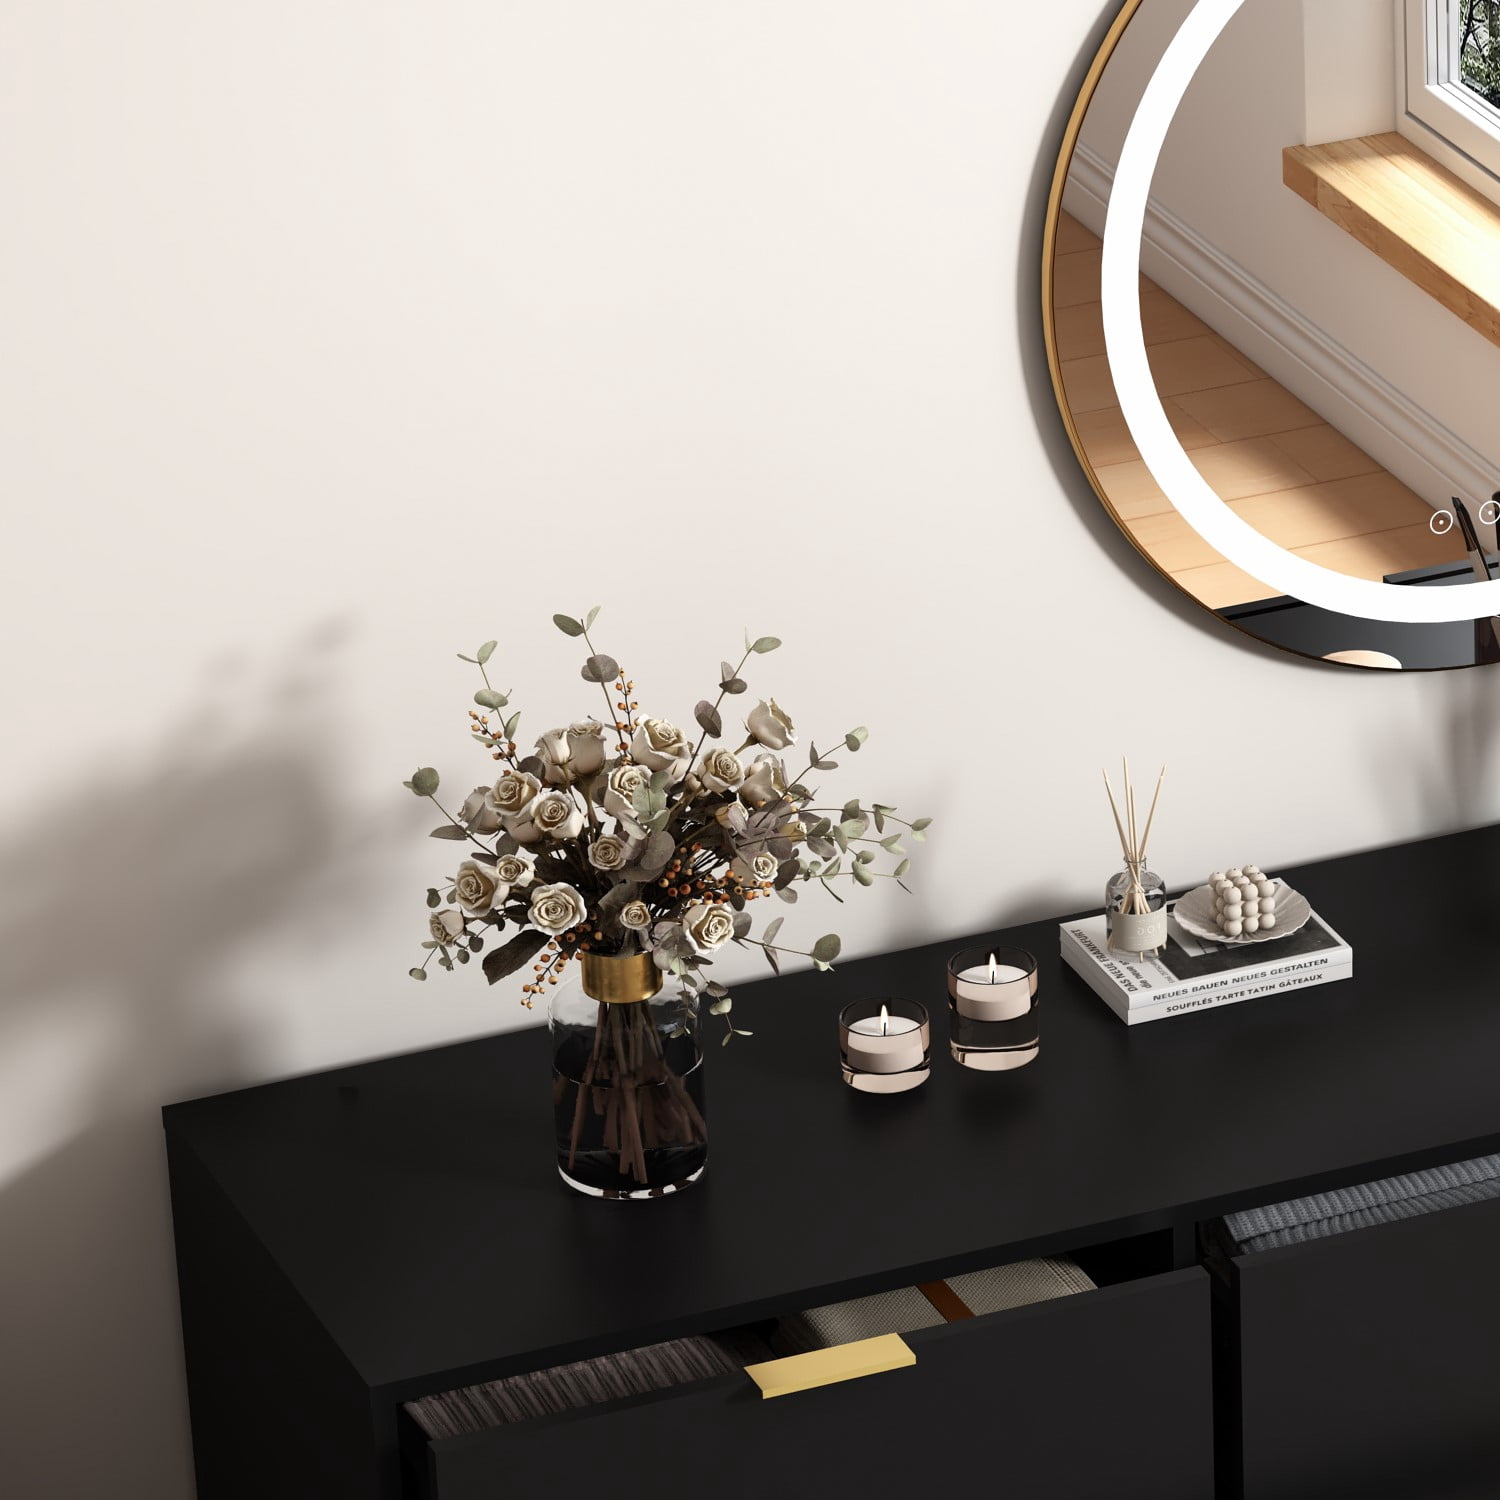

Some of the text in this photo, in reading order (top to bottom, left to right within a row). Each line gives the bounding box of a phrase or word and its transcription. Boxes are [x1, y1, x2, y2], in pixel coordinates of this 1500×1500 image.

[1069, 928, 1139, 992] DAS NEUE FRANKFURT
[1125, 965, 1144, 979] neue
[1137, 979, 1153, 989] die
[1152, 958, 1328, 1001] NEUES BAUEN NEUES GESTALTEN
[1166, 998, 1213, 1013] SOUFFLÉS
[1216, 990, 1245, 1002] TARTE
[1248, 984, 1275, 995] TATIN
